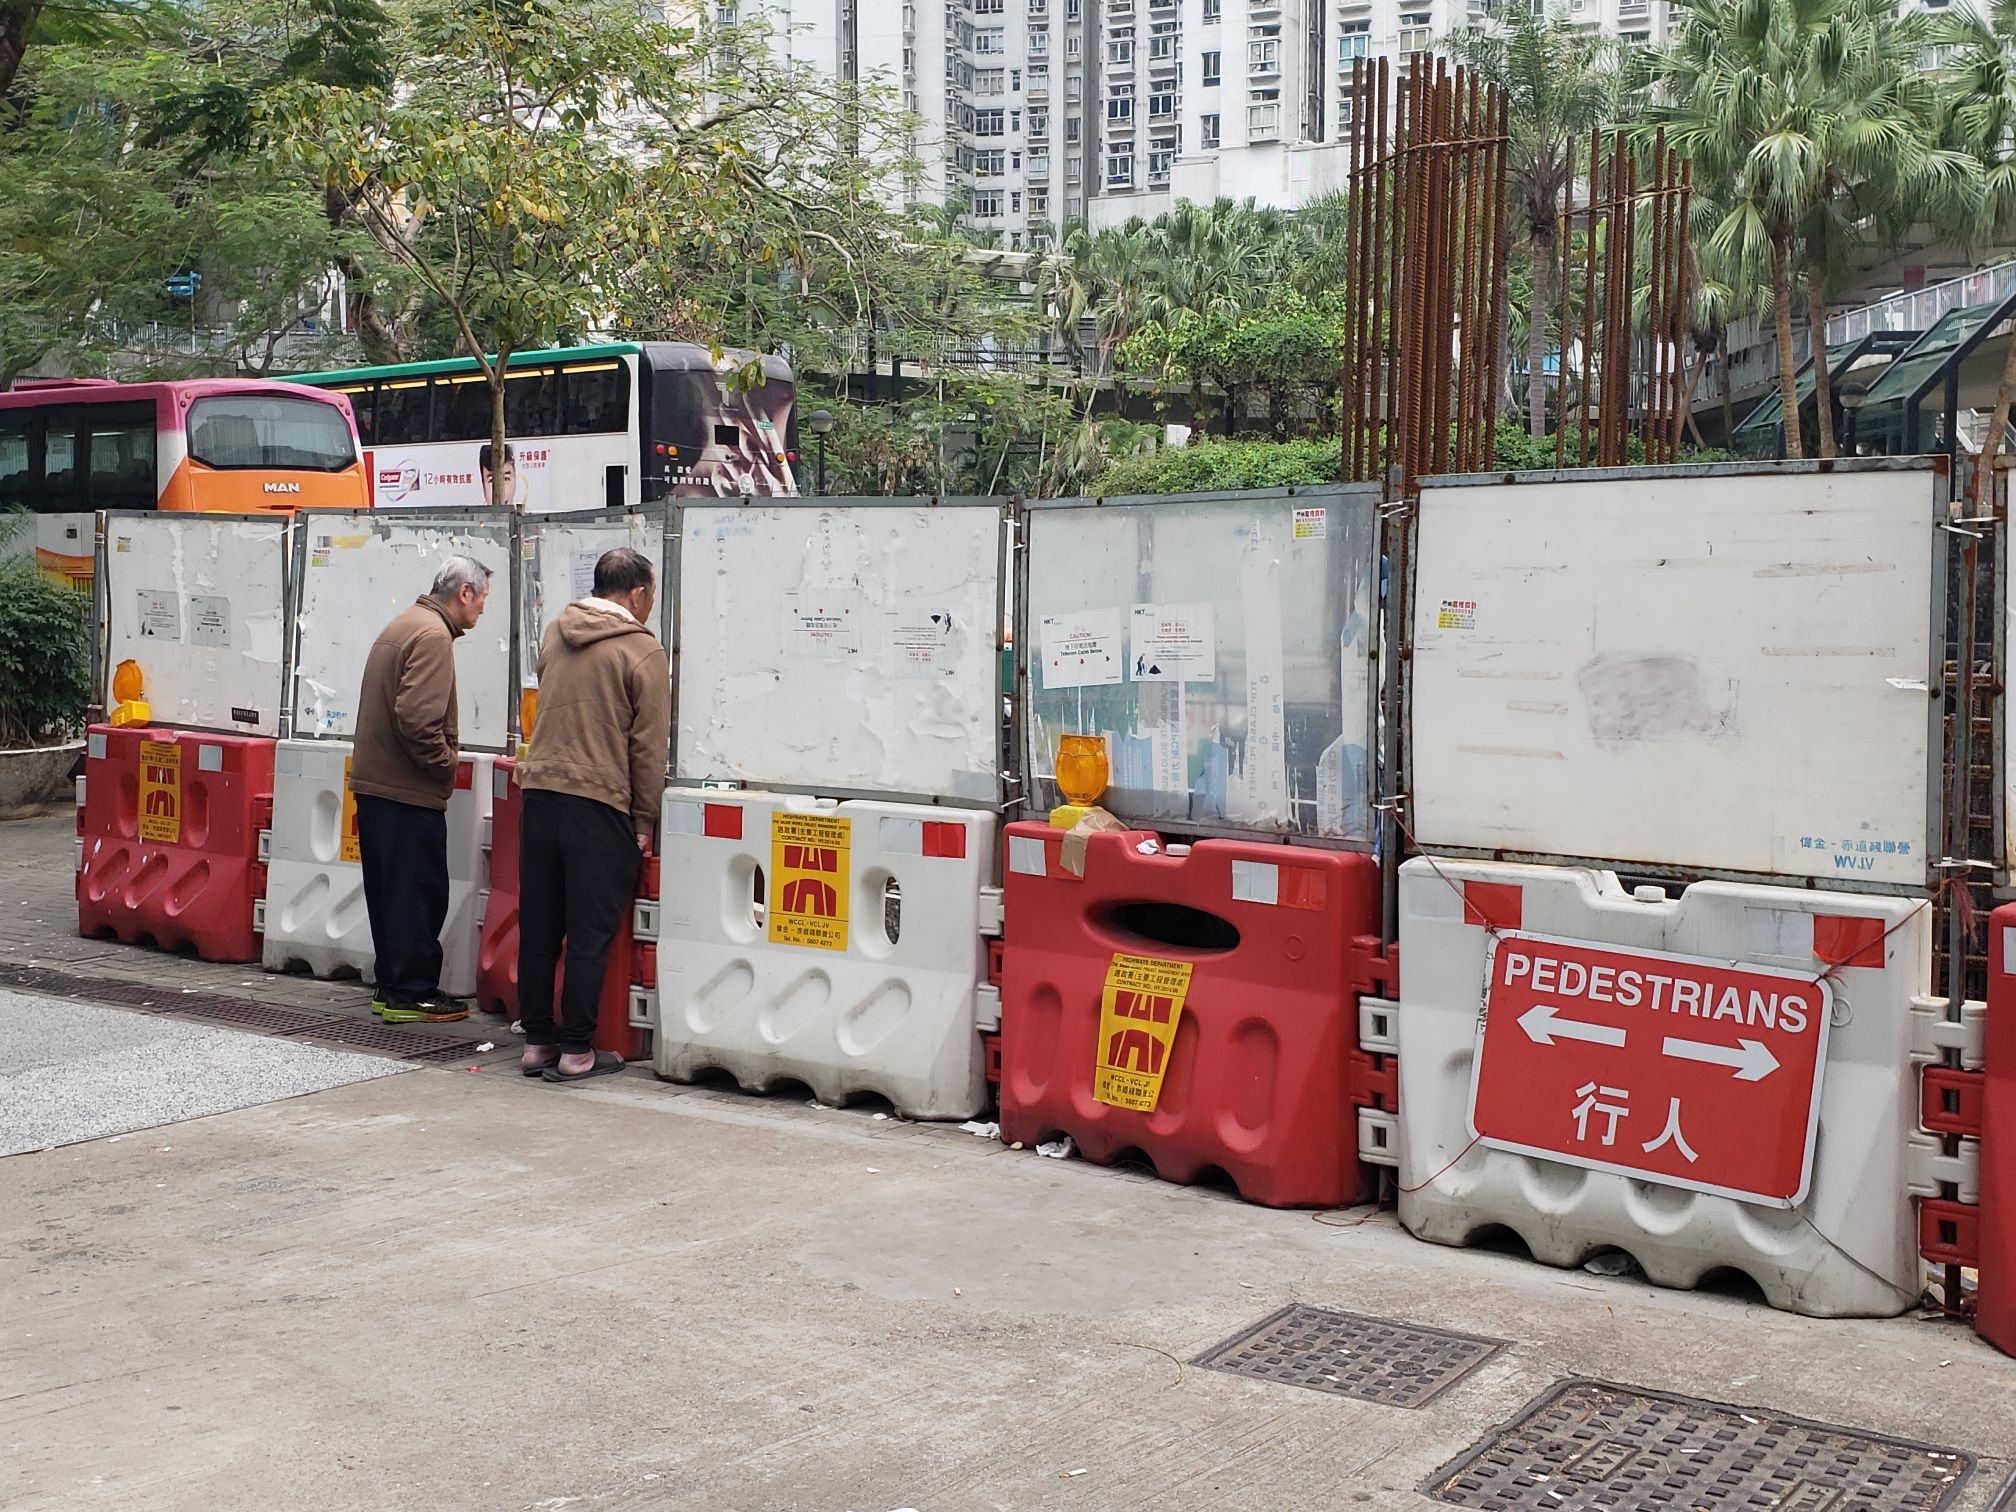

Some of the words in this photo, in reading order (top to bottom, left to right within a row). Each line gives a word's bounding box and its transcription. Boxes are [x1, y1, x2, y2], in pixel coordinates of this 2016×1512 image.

[264, 482, 300, 492] MAN
[1123, 957, 1148, 965] HIGHWAYS
[1150, 960, 1184, 969] DEPARTMENT
[1504, 953, 1808, 1033] PEDESTRIANS
[1130, 1078, 1142, 1086] VCL
[1572, 1081, 1699, 1163] 行人
